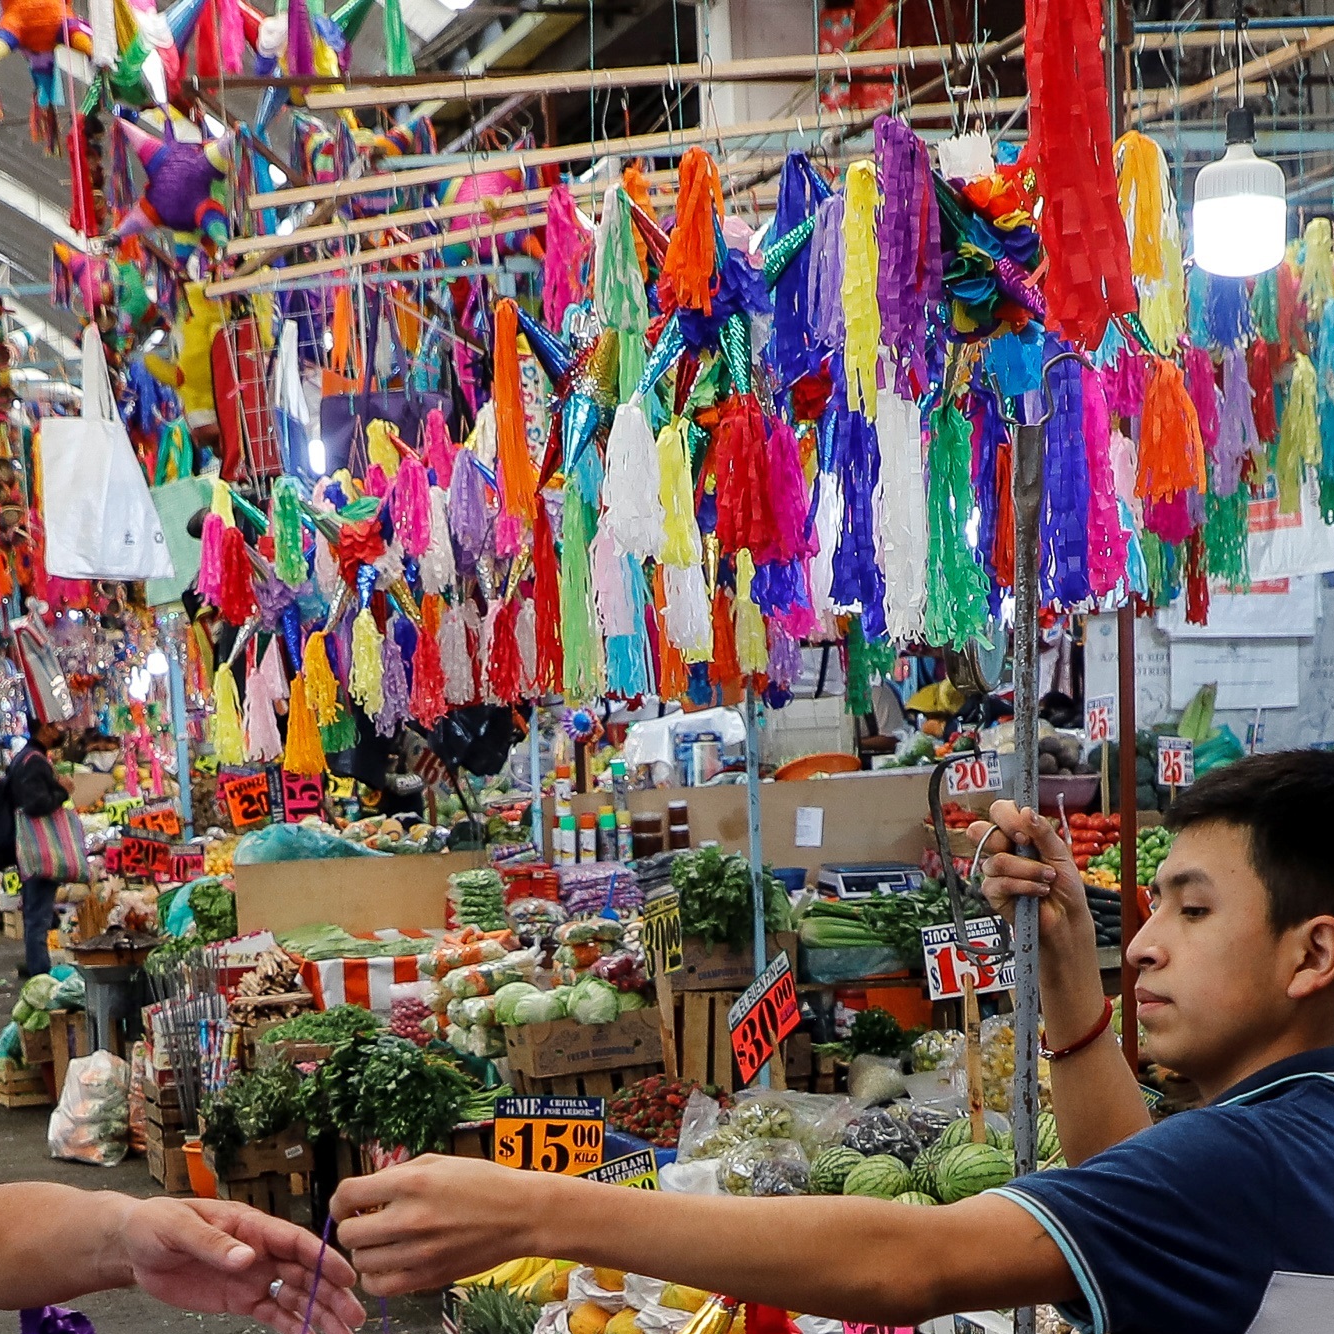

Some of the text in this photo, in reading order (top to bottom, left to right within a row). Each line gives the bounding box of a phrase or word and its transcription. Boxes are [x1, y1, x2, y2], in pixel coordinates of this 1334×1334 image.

[1089, 707, 1109, 741] 25
[999, 967, 1017, 985] KIL
[499, 1122, 601, 1174] $15 00
[573, 1152, 599, 1164] KILO
